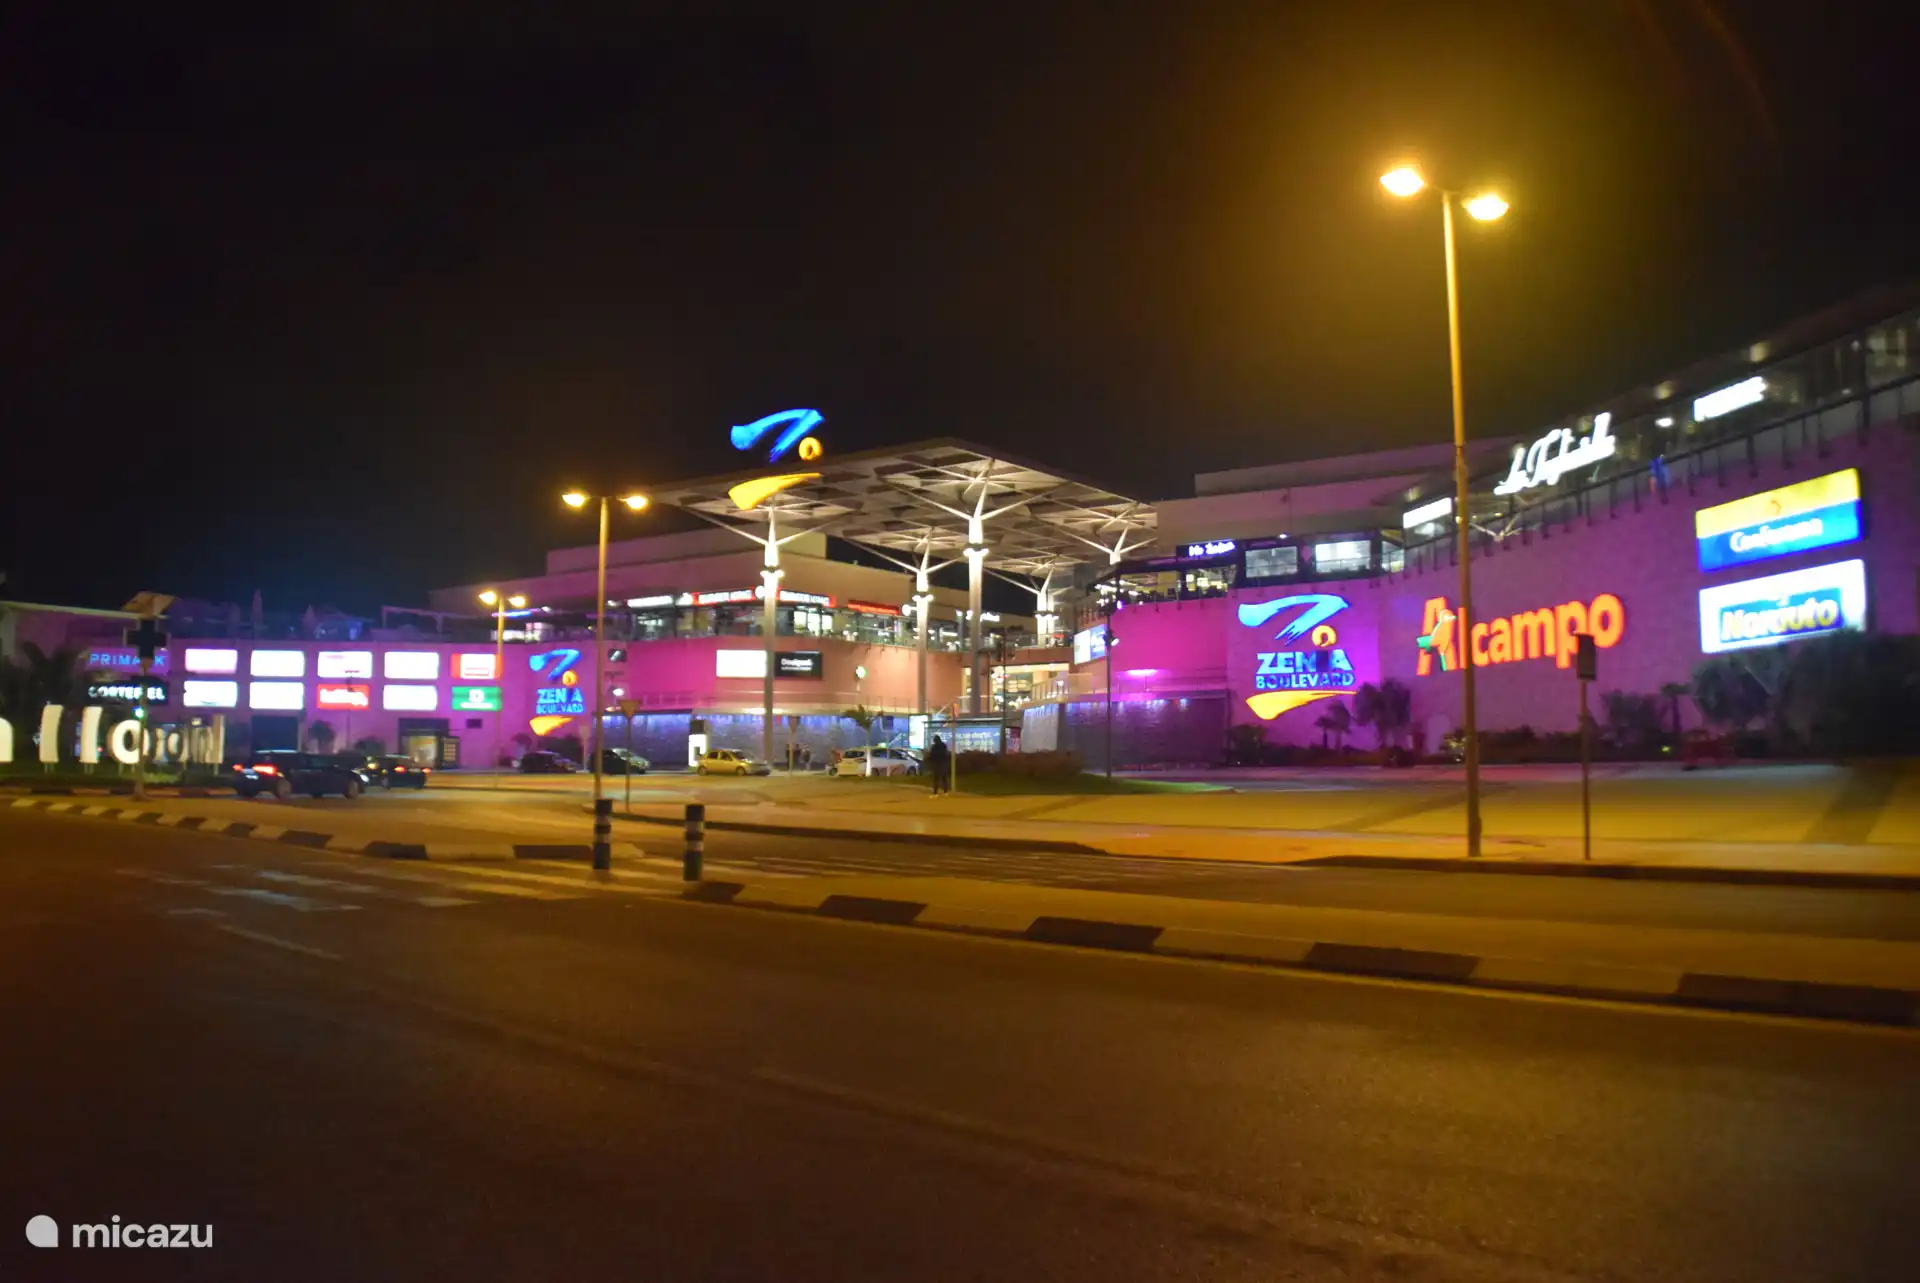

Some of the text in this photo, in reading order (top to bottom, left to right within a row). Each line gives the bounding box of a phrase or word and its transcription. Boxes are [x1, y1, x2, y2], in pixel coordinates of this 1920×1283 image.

[1721, 597, 1838, 642] Norauto
[1416, 593, 1625, 677] Alcampo
[89, 653, 165, 666] PRIMAK
[1255, 672, 1356, 690] BOULEVARD
[88, 685, 165, 701] CORTEFEL
